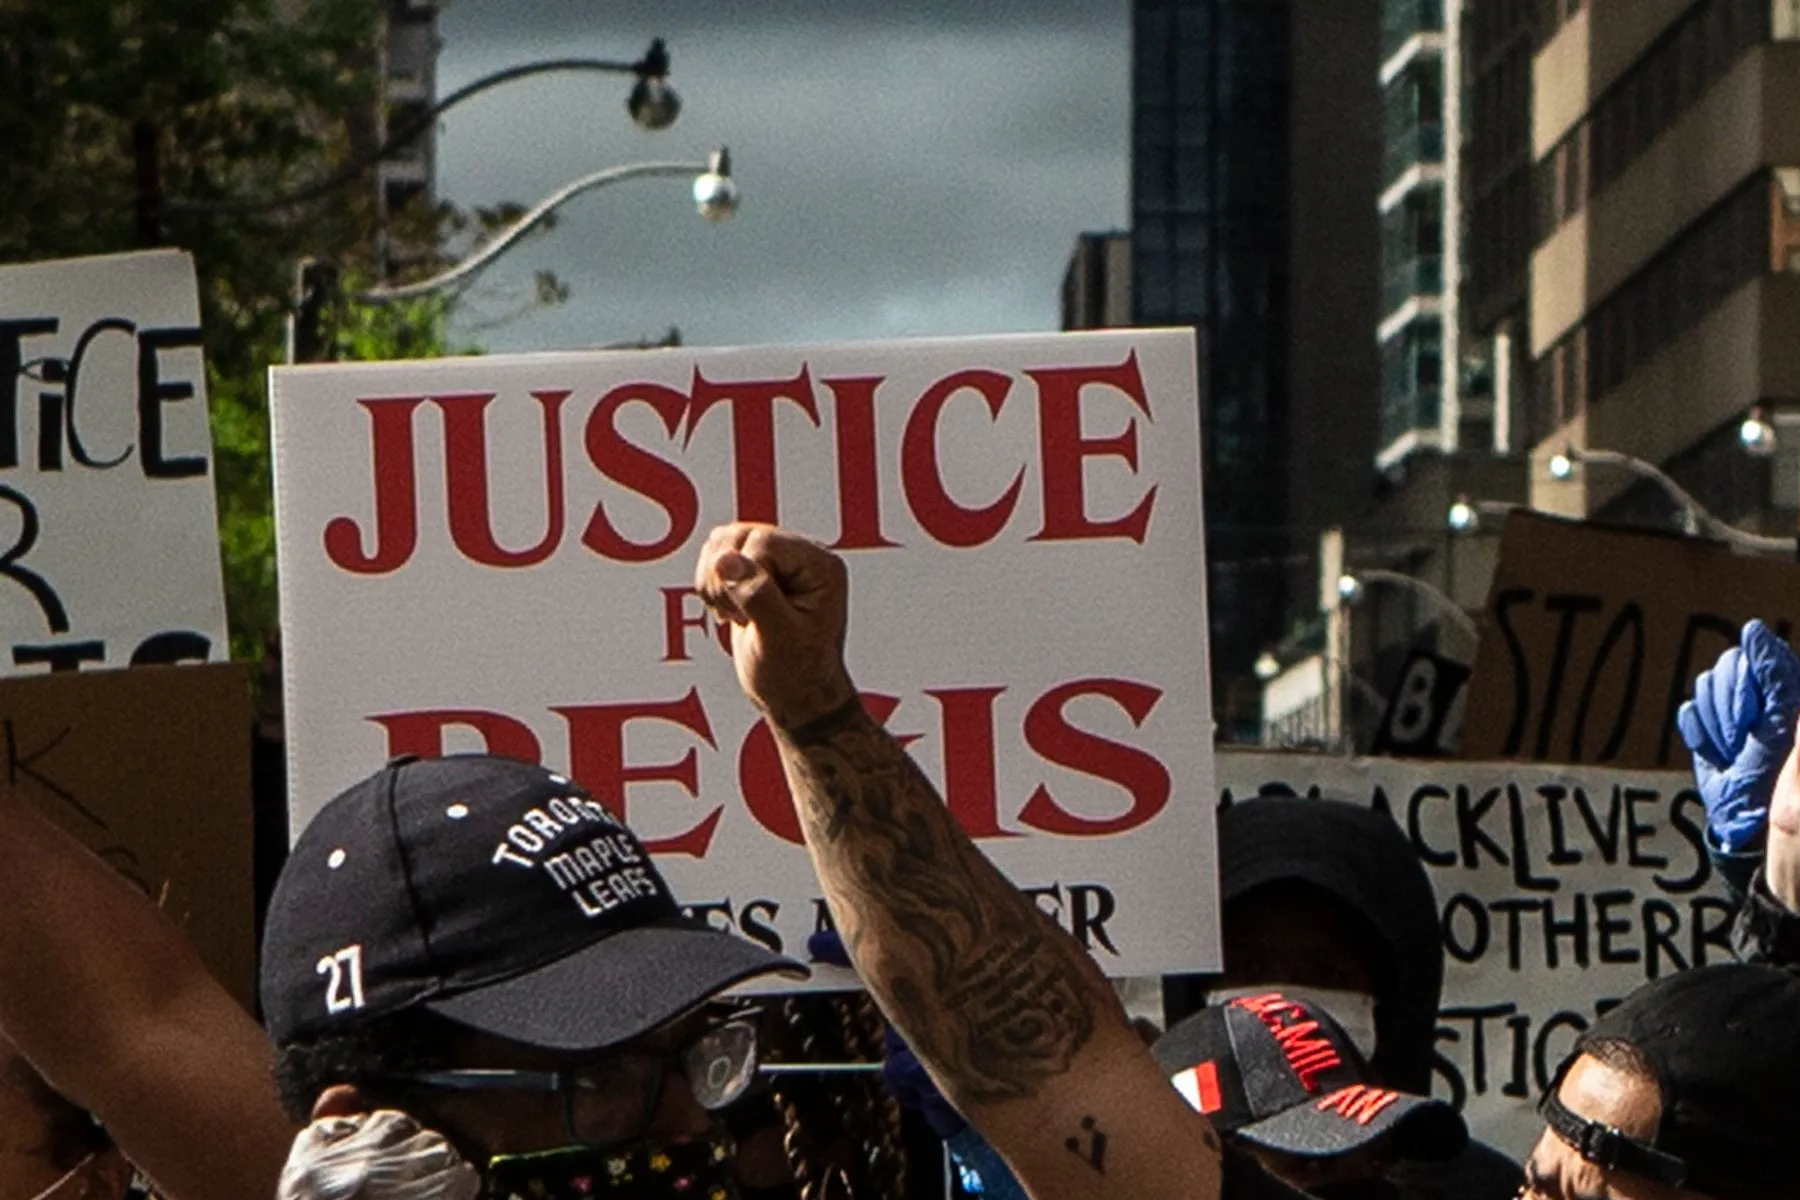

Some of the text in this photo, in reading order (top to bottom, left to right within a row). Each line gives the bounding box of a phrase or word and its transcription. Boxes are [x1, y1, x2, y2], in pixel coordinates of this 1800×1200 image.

[323, 347, 1160, 575] JUSTICE
[543, 832, 642, 892] MAPLE
[317, 944, 365, 1015] 27
